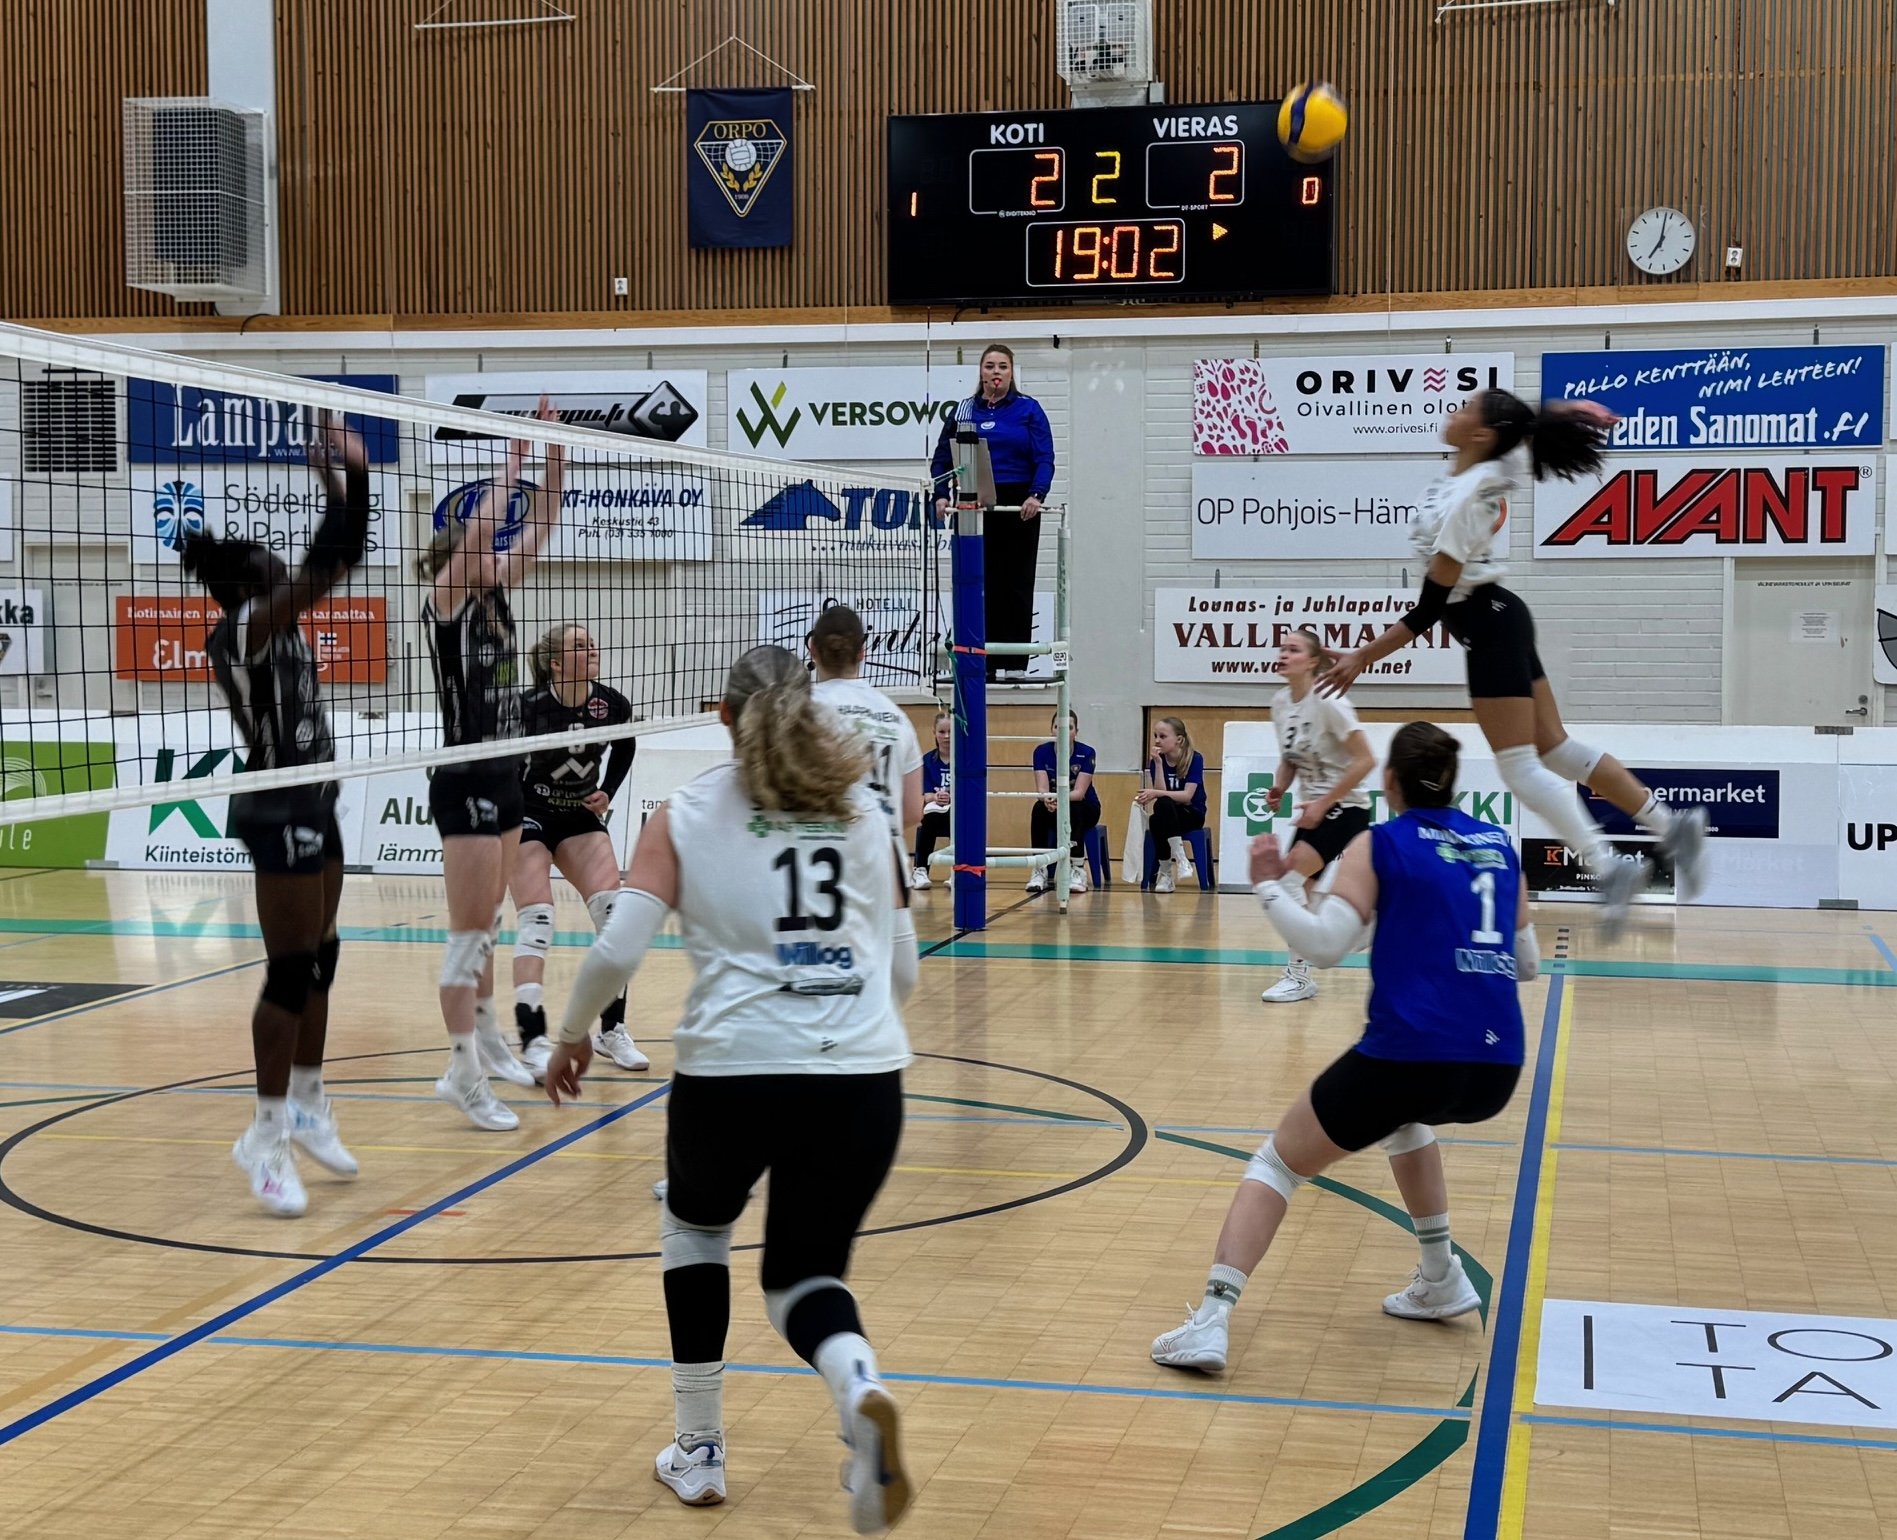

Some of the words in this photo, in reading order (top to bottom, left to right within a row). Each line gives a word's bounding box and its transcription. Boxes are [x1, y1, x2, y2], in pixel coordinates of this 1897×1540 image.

[714, 123, 766, 140] ORPO
[990, 123, 1045, 145] KOTI
[1153, 115, 1239, 138] VIERAS
[1030, 153, 1060, 206] 2
[1092, 151, 1120, 203] 2
[1209, 147, 1239, 200] 2
[1054, 225, 1178, 280] 19:02
[1564, 374, 1628, 400] PALLO
[1634, 352, 1751, 387] KENTTÄÄN,
[1698, 375, 1751, 399] NIMI
[1757, 356, 1863, 389] LEHTEEN!
[1297, 400, 1413, 418] Oivallinen
[1352, 422, 1438, 435] www.orivesi.fi
[1605, 407, 1678, 446] eden
[225, 483, 382, 522] Söderbg
[680, 489, 704, 507] OY
[1198, 498, 1234, 525] OP
[1243, 497, 1418, 530] Pohjois-Häm
[1188, 596, 1266, 613] Lounas-
[1274, 595, 1294, 615] ja
[1302, 595, 1416, 615] Juhlapalve
[145, 845, 251, 864] Kiinteistöm
[773, 847, 844, 932] 13
[1470, 872, 1504, 944] 1
